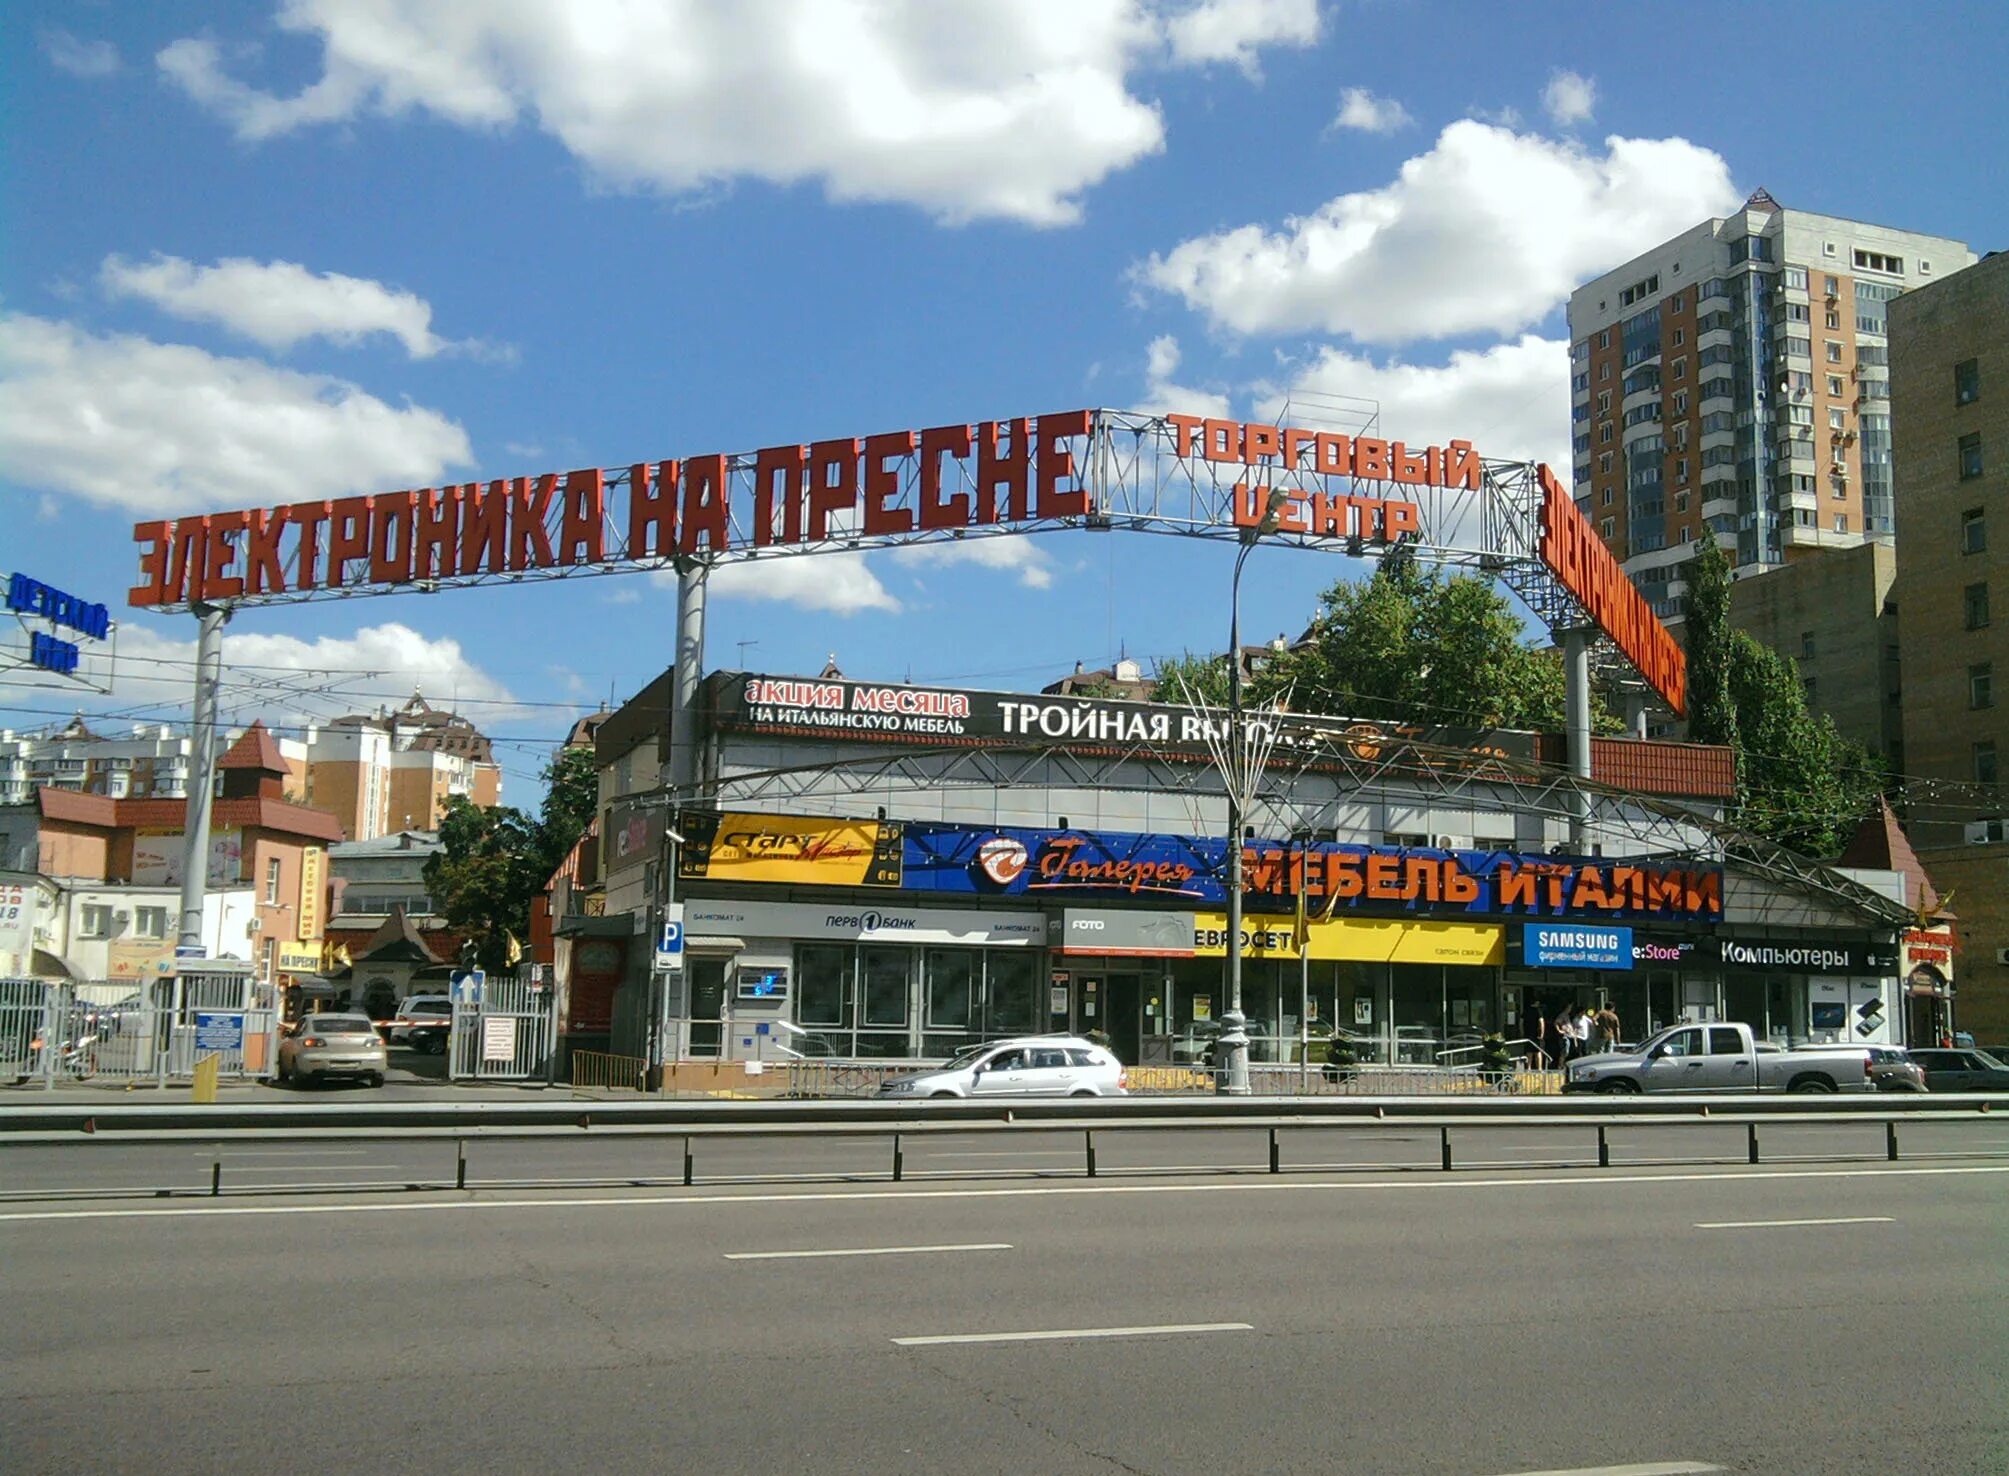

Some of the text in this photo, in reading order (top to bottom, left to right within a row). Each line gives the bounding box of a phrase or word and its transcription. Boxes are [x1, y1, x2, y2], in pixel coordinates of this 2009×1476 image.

[1167, 413, 1481, 491] ТОРГОВЫЙ
[128, 409, 1090, 607] ЭЛЕКТРОНИКА НА ПРЕСНЕ
[1234, 483, 1417, 542] ЦЕНТР
[744, 679, 971, 718] акция месяца
[750, 706, 965, 734] НА ИТАЛЬЯНСКУЮ МЕБЕЛЬ
[997, 702, 1169, 741] ТРОЙНАЯ
[1041, 836, 1194, 893] Галерея
[1241, 848, 1722, 914] МЕБЕЛЬ ИТАЛИИ
[1072, 920, 1105, 930] FOTO
[1538, 931, 1618, 950] SAMSUNG
[1721, 941, 1849, 970] Компьютеры
